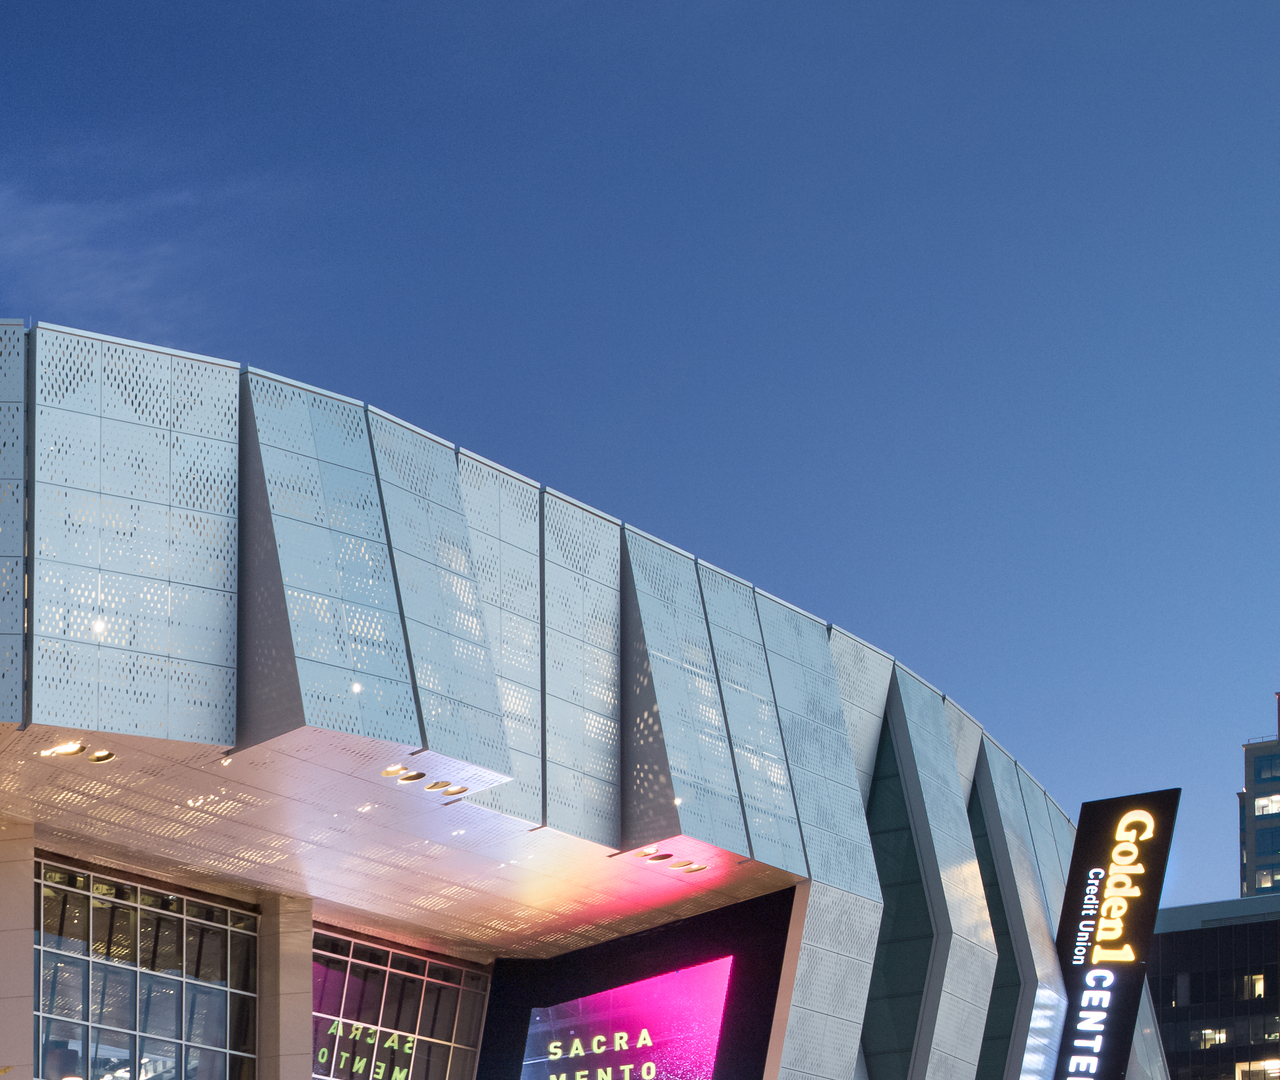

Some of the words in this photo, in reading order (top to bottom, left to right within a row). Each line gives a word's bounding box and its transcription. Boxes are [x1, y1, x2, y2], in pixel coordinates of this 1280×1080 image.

[1082, 867, 1105, 917] Credit
[1072, 919, 1096, 966] Union
[547, 1028, 653, 1060] SACRA
